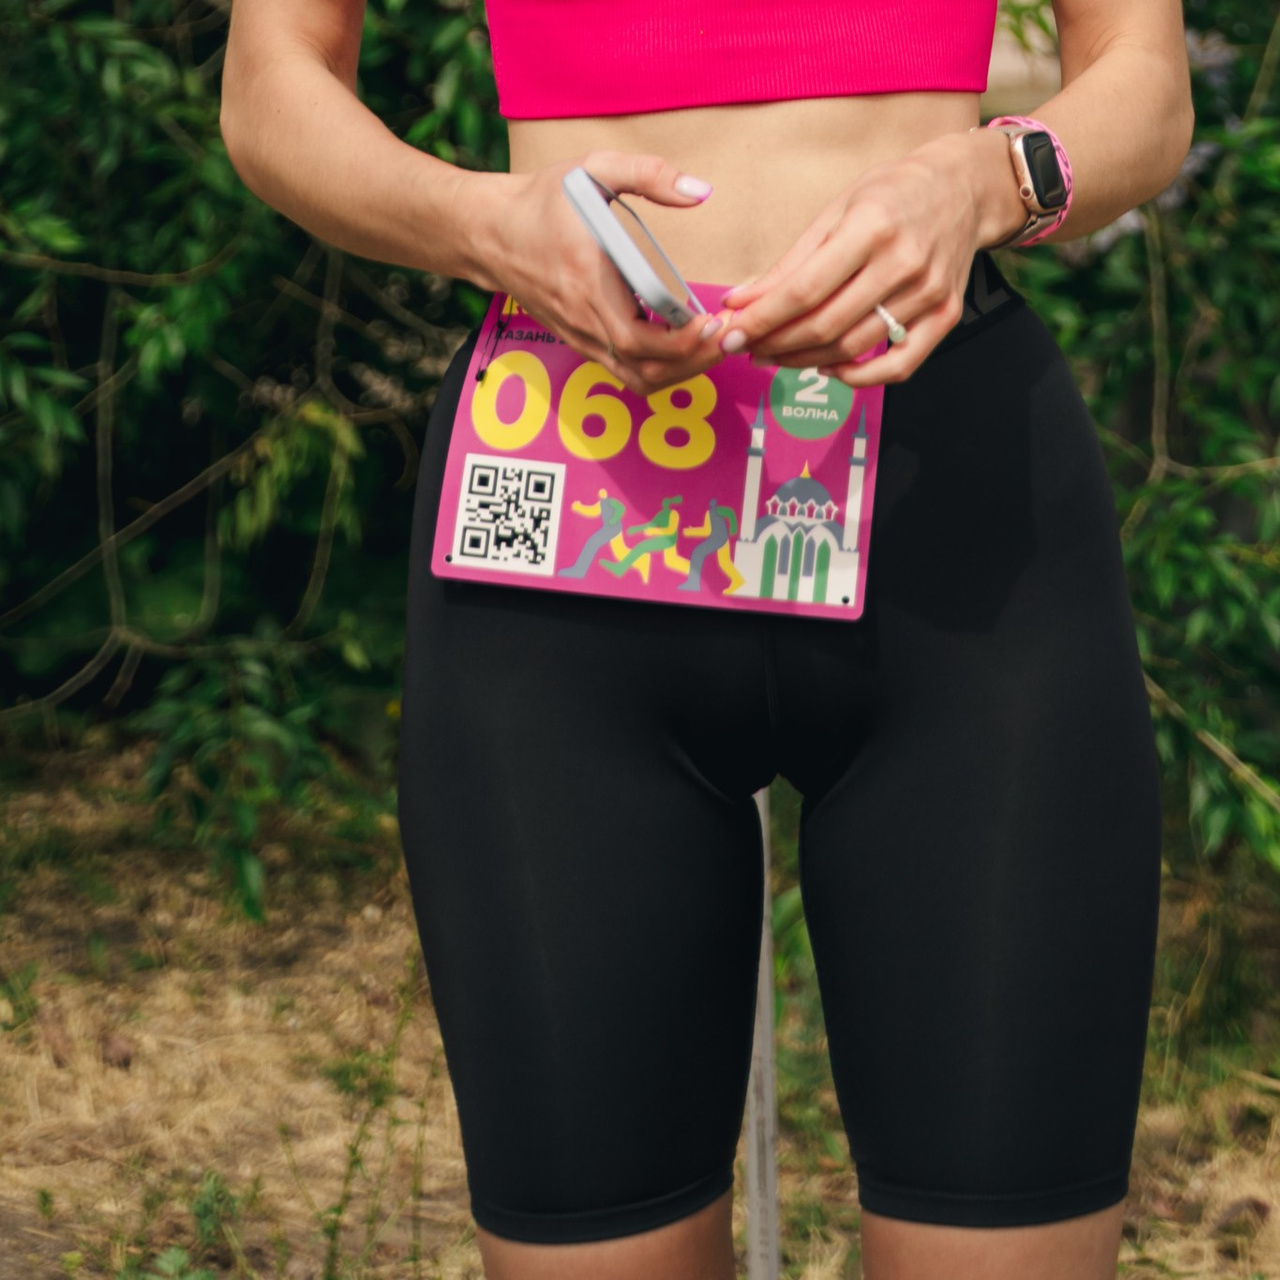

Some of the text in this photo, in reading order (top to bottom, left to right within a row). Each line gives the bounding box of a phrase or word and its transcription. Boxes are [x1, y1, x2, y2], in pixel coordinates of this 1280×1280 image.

[794, 366, 829, 404] 2
[471, 350, 718, 471] 068
[782, 405, 839, 421] ВОЛНА
